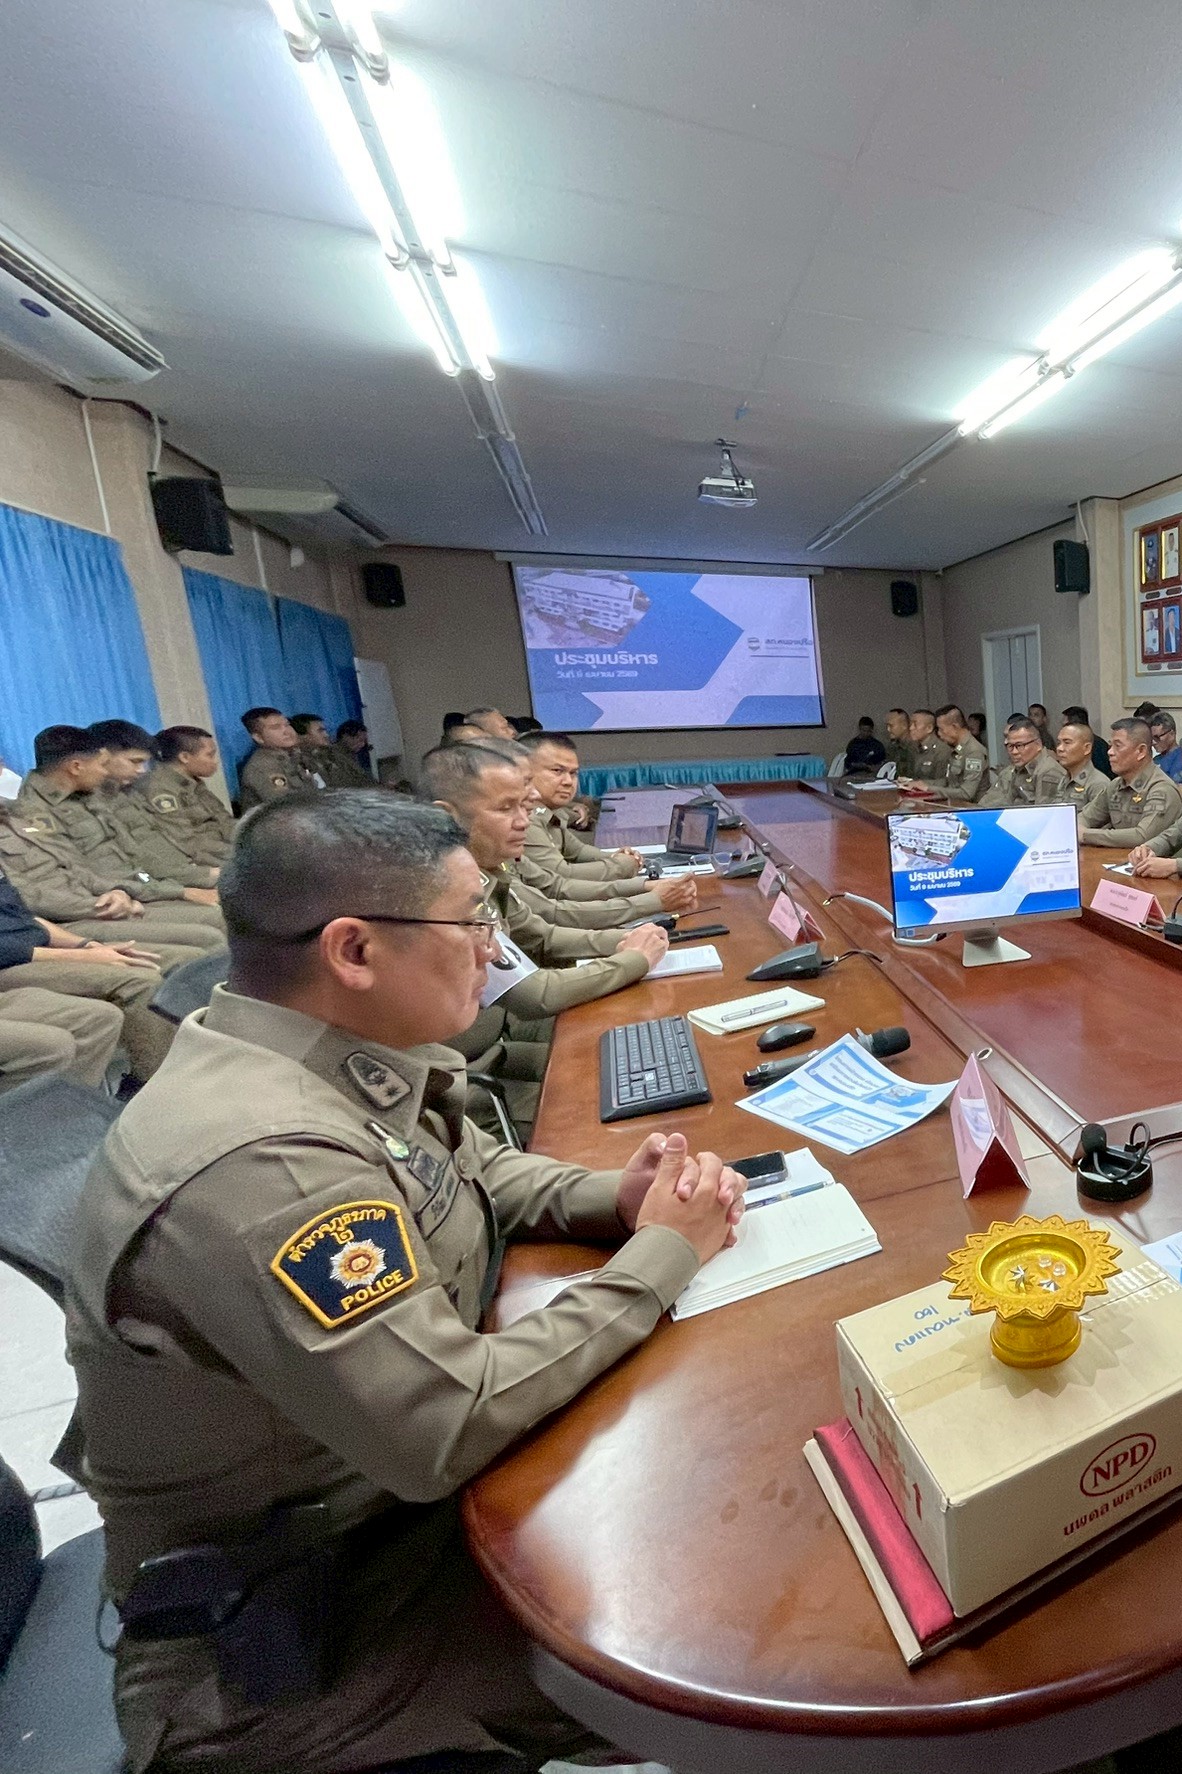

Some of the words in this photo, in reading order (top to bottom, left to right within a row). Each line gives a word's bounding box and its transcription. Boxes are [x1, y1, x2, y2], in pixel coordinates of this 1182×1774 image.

[554, 650, 658, 669] ประชุมบริหาร
[908, 867, 975, 883] ประชุมบริหาร
[288, 1208, 386, 1262] ตำรวจภูธรภาค
[340, 1269, 404, 1311] POLICE
[1092, 1441, 1149, 1489] NPD
[1063, 1503, 1109, 1536] นพดล
[1112, 1465, 1172, 1507] พลาสติก
